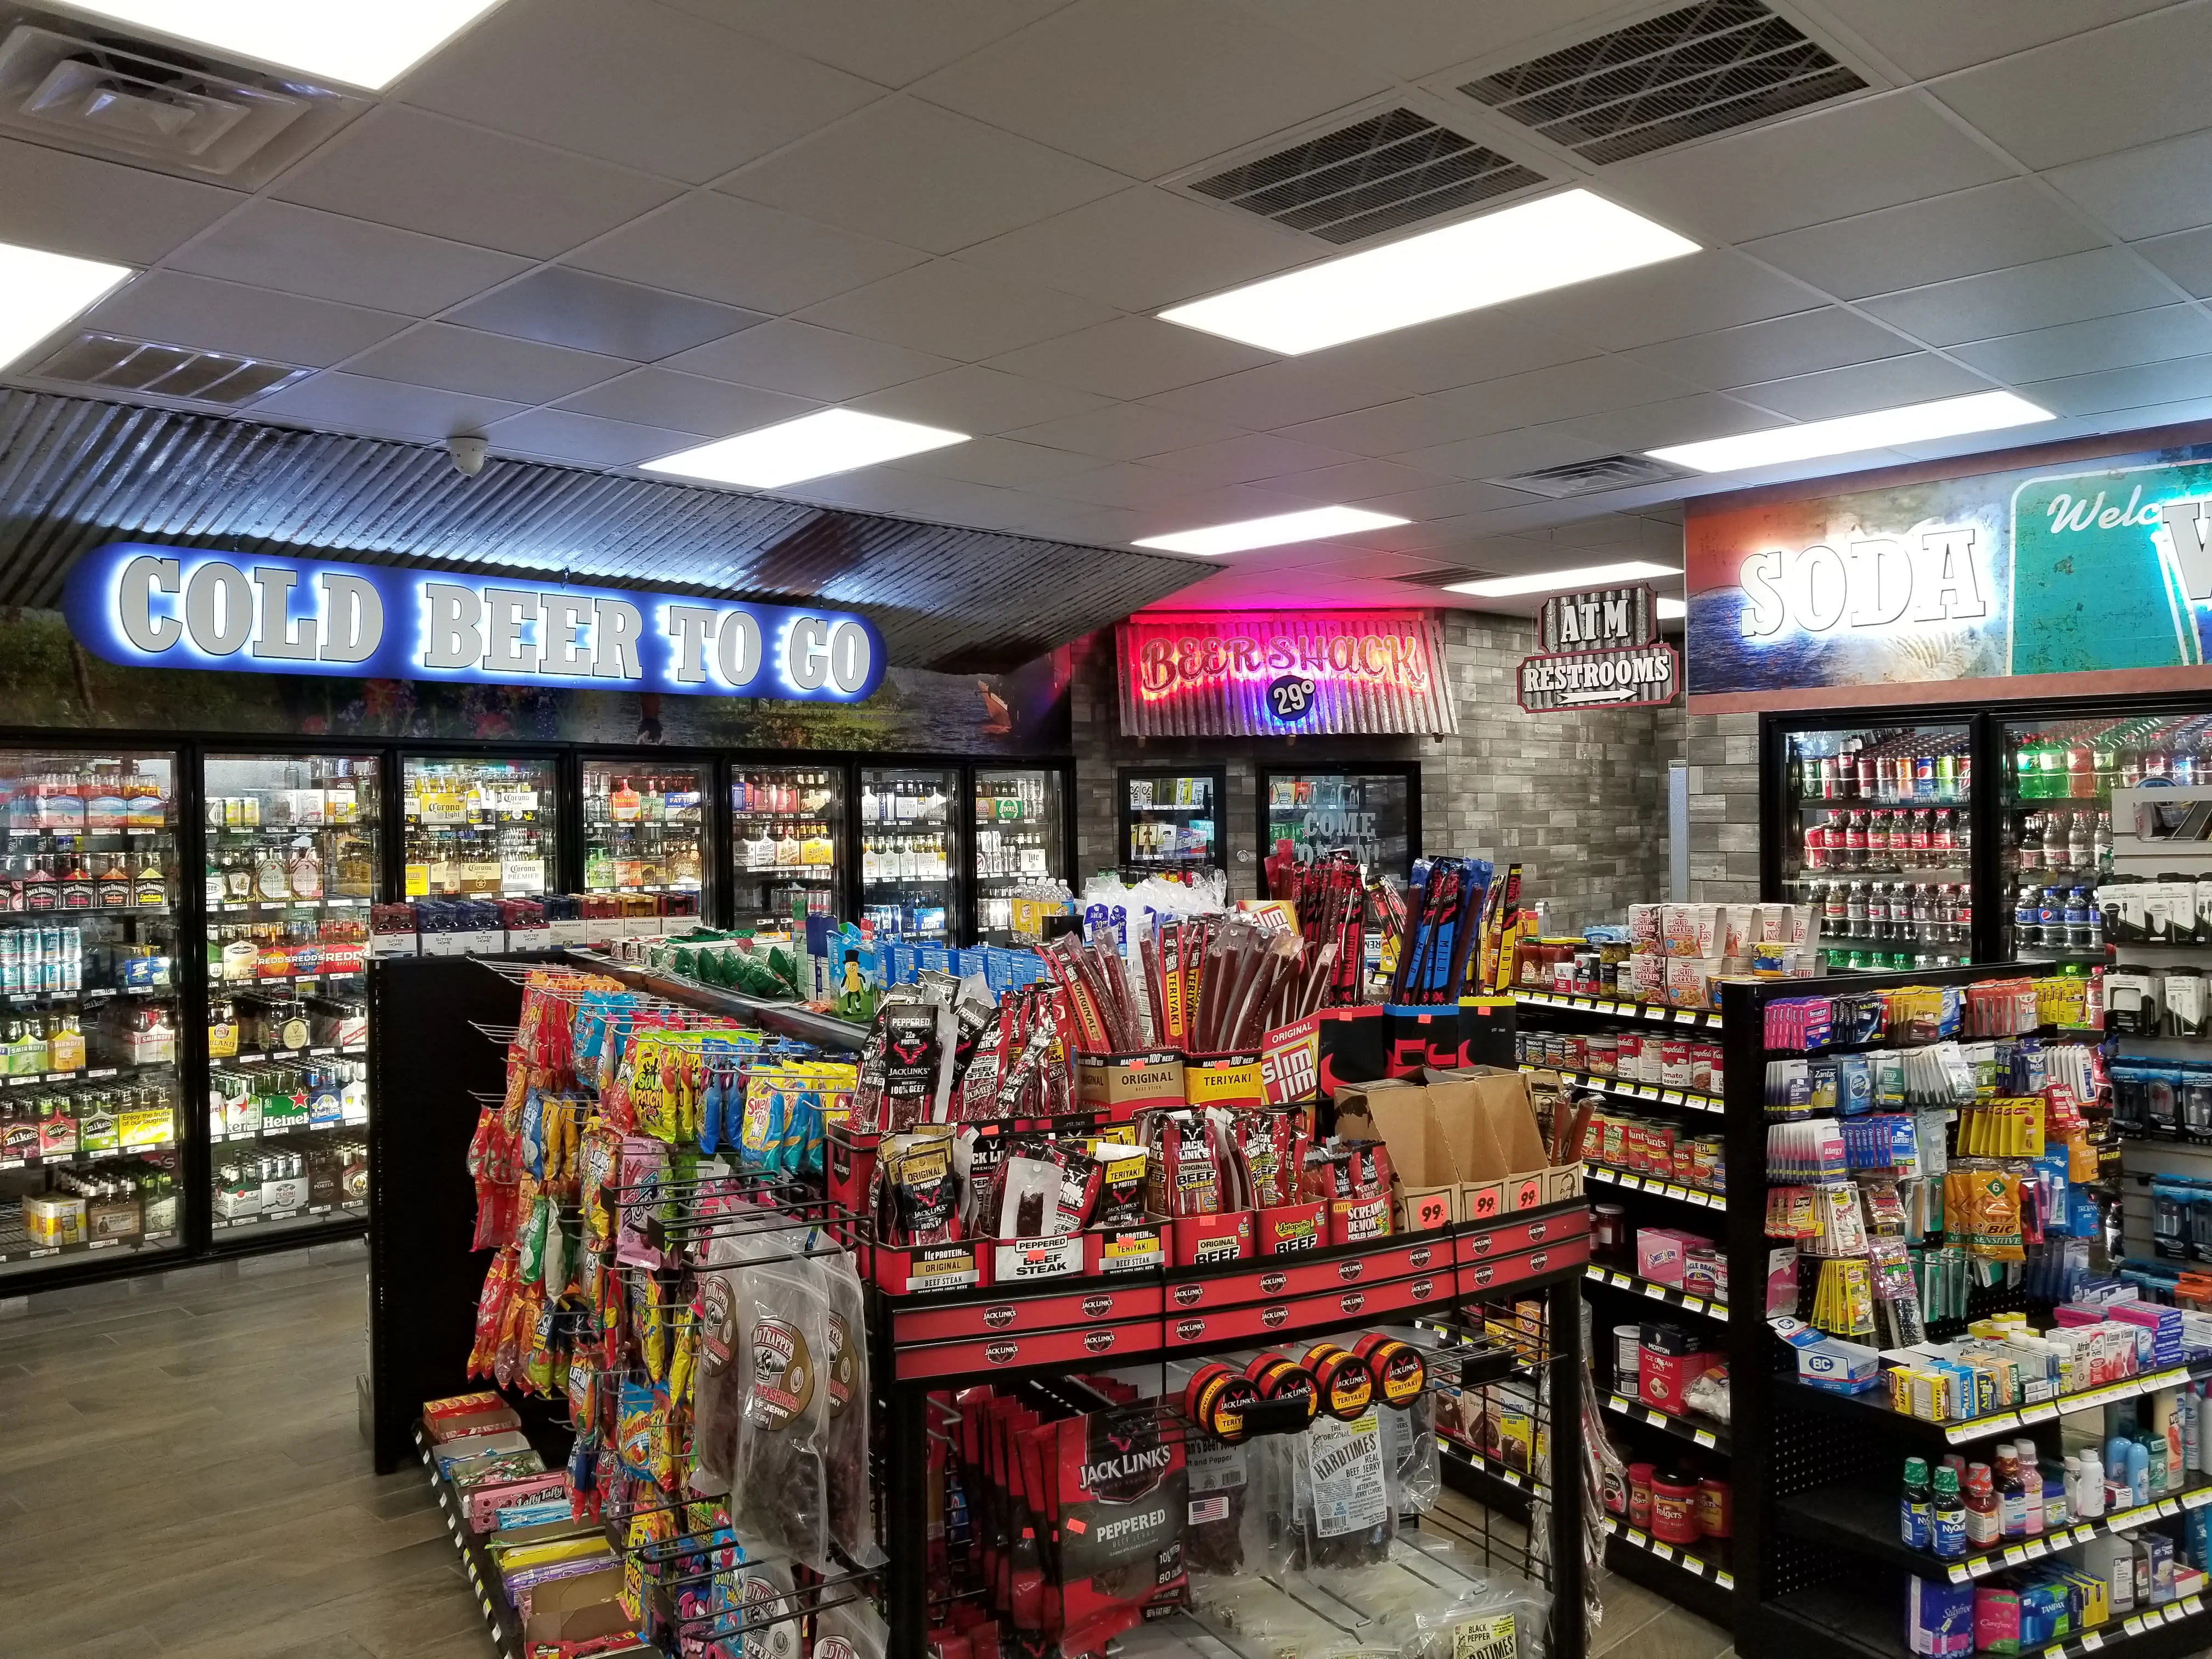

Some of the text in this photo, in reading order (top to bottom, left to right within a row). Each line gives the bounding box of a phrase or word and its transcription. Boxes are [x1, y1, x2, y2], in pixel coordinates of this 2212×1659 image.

[1739, 529, 1986, 638] SODA
[119, 555, 871, 692] COLD BEER TO GO
[1561, 600, 1628, 642] ATM
[1141, 635, 1428, 693] BEER SHACK
[1524, 656, 1669, 692] RESTROOMS
[1304, 812, 1375, 836] COME
[631, 871, 641, 879] IPA
[1667, 926, 1694, 934] NOODLES
[1436, 940, 1448, 972] MILD
[1640, 966, 1654, 974] CUP
[1678, 968, 1694, 977] CUP
[1635, 972, 1660, 981] NOODLES
[1672, 975, 1700, 984] NOODLES
[1169, 973, 1182, 1026] TERIYAKI
[1073, 983, 1097, 1032] ORIGINAL
[1809, 1008, 1827, 1017] Benadryl
[892, 1018, 930, 1026] PEPPERED
[958, 1007, 985, 1028] PEPPERED
[1272, 1022, 1312, 1044] ORIGINAL
[11, 1046, 44, 1054] SMIRNOFF
[966, 1071, 996, 1080] STEAK
[1121, 1071, 1173, 1085] ORIGINAL
[1204, 1073, 1251, 1086] TERIYAKI
[891, 1086, 907, 1094] 100%
[635, 1090, 663, 1108] PATCH
[86, 1120, 112, 1132] mike's
[5, 1131, 39, 1145] mike's
[1182, 1140, 1204, 1151] JACK
[1180, 1164, 1211, 1172] ORIGINAL
[908, 1167, 943, 1182] ORIGINAL
[1110, 1169, 1141, 1180] TERIYAKI
[1176, 1170, 1216, 1188] BEEF
[920, 1178, 941, 1189] PROTEIN
[1993, 1183, 2000, 1192] 6
[1334, 1203, 1351, 1212] HOT!
[1347, 1221, 1376, 1233] DEMON
[1348, 1232, 1365, 1241] PICKLED
[1974, 1236, 2023, 1245] SENSITIVE
[1019, 1238, 1066, 1250] PEPPERED
[1200, 1238, 1235, 1249] ORIGINAL
[1276, 1234, 1317, 1254] BEEF
[934, 1248, 962, 1257] PROTEIN
[926, 1261, 962, 1272] ORIGINAL
[1116, 1256, 1150, 1267] BEEF STEAK
[1016, 1262, 1066, 1276] STEAK
[924, 1276, 963, 1286] BEEF STEAK
[1780, 1319, 1793, 1328] BC
[761, 1333, 795, 1361] TRAPPER
[1648, 1342, 1671, 1355] MORTON
[2076, 1342, 2090, 1352] Afrin
[1645, 1354, 1654, 1362] ICE
[1811, 1358, 1831, 1370] BC
[1391, 1381, 1418, 1393] TERIYAKI
[763, 1387, 799, 1412] FASHIONED
[1336, 1392, 1365, 1404] TERIYAKI
[764, 1403, 789, 1419] JERKY
[1323, 1430, 1350, 1440] ORIGINAL
[1194, 1455, 1232, 1465] and Pepper
[1313, 1432, 1376, 1481] HARDTIMES
[1364, 1453, 1379, 1463] REAL
[1079, 1445, 1171, 1490] JACK LINK'S
[1346, 1462, 1380, 1477] BEEF JERKY
[1357, 1481, 1379, 1491] ATTENTION:
[1368, 1486, 1382, 1494] LOVERS
[516, 1485, 563, 1506] Laffy Taffy
[1656, 1503, 1683, 1520] Folgers
[1097, 1509, 1165, 1543] PEPPERED
[1942, 1522, 1966, 1533] NyQuil
[1943, 1604, 1972, 1620] Stayfree
[2040, 1601, 2065, 1614] TAMPAX
[1469, 1623, 1487, 1633] BLACK
[1980, 1618, 2013, 1629] Carefree
[1468, 1633, 1490, 1643] PEPPER
